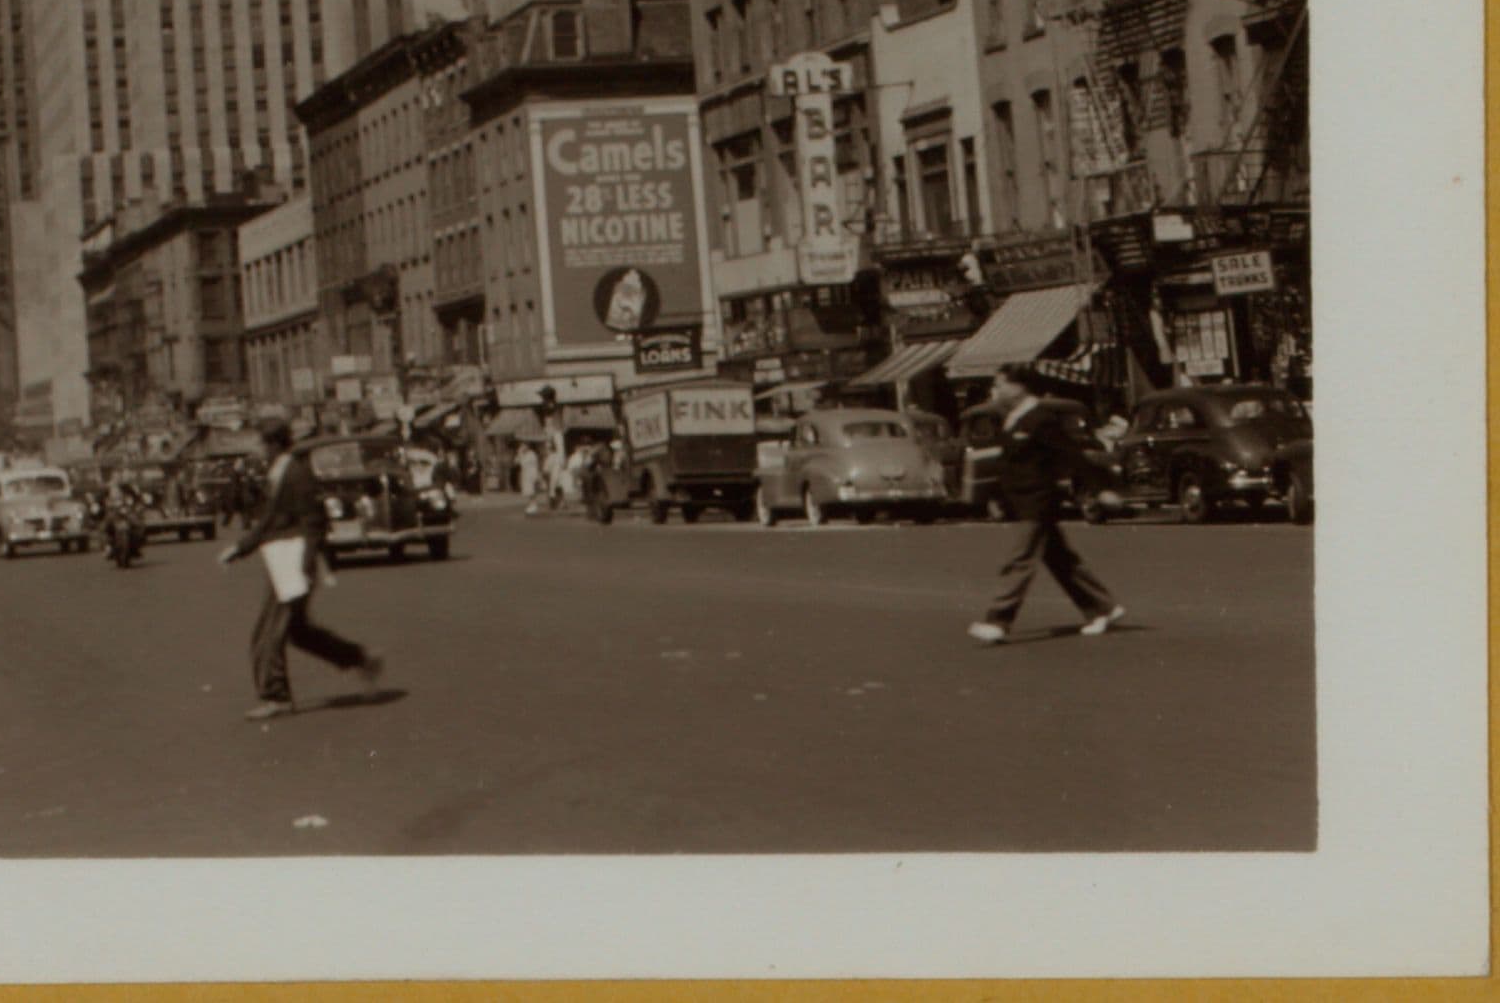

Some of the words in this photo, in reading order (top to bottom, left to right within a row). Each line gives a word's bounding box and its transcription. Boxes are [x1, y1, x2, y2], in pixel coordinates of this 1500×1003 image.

[782, 69, 842, 93] AL'S
[546, 123, 686, 176] Camels
[803, 106, 837, 236] BAR
[615, 181, 673, 211] LESS
[560, 212, 685, 245] NICOTINE
[1216, 255, 1262, 273] SALE
[640, 347, 692, 365] LOANS
[673, 399, 750, 421] FINK
